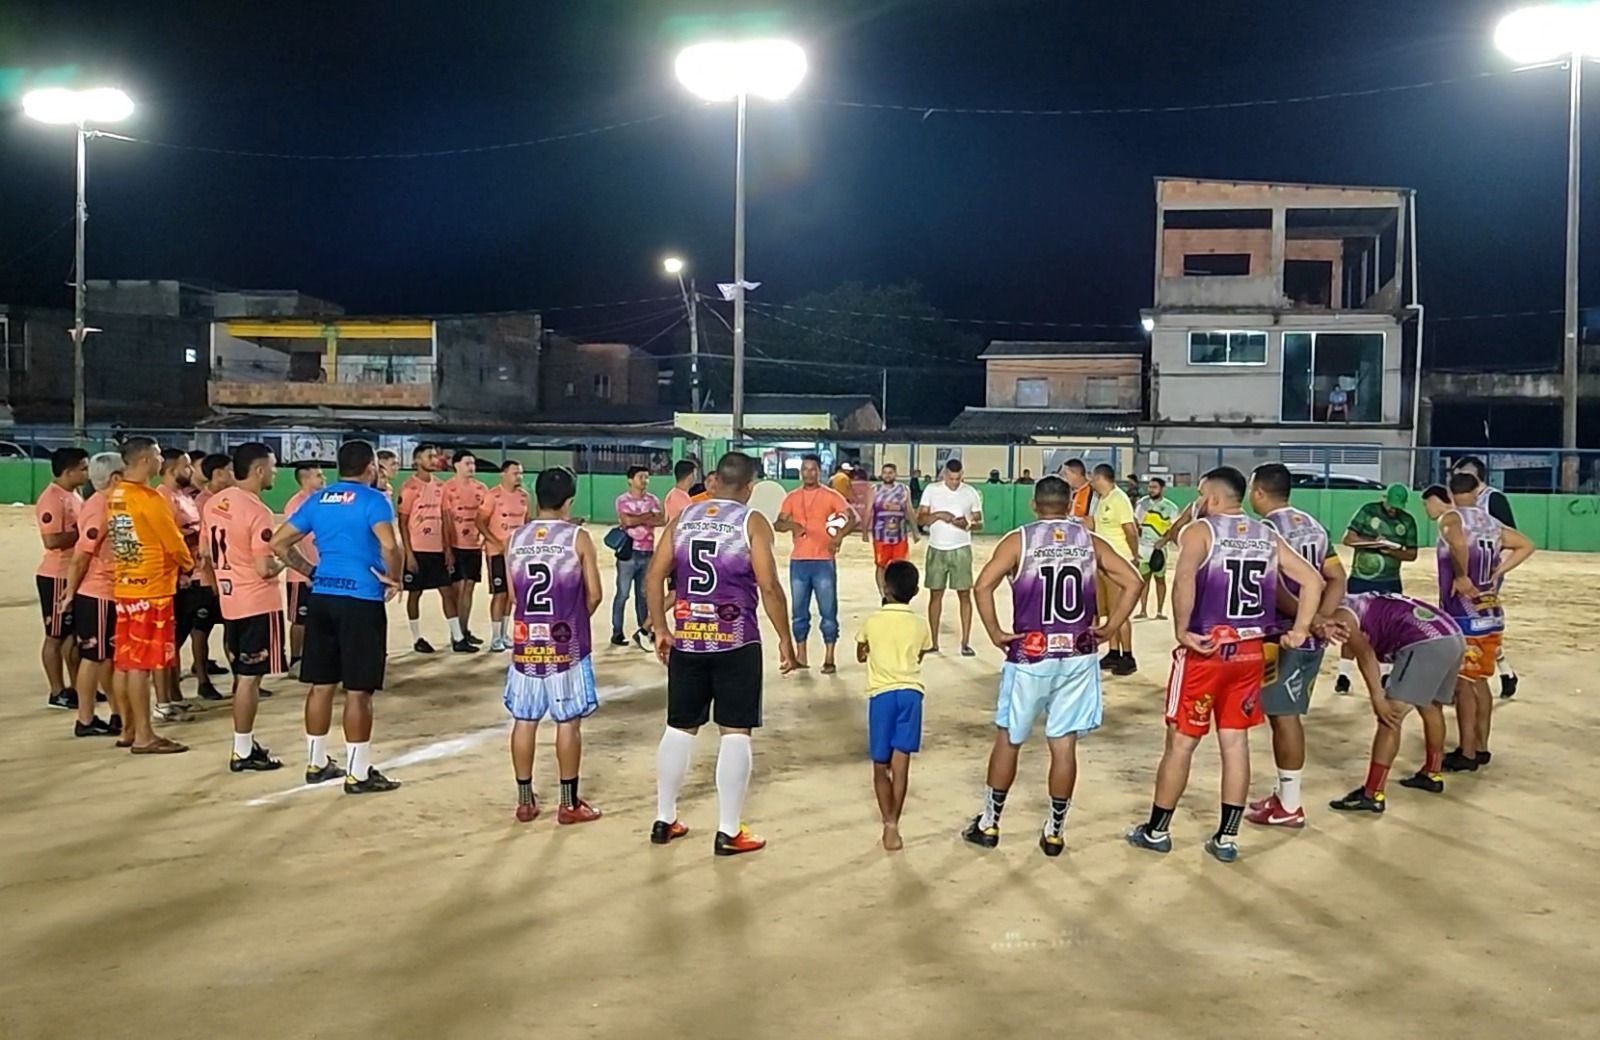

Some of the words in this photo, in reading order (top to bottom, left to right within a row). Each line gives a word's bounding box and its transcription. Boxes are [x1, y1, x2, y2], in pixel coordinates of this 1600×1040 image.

[524, 561, 553, 615] 2
[688, 538, 719, 595] 5
[1223, 557, 1269, 619] 15
[1478, 538, 1495, 585] 11
[1039, 564, 1085, 624] 10
